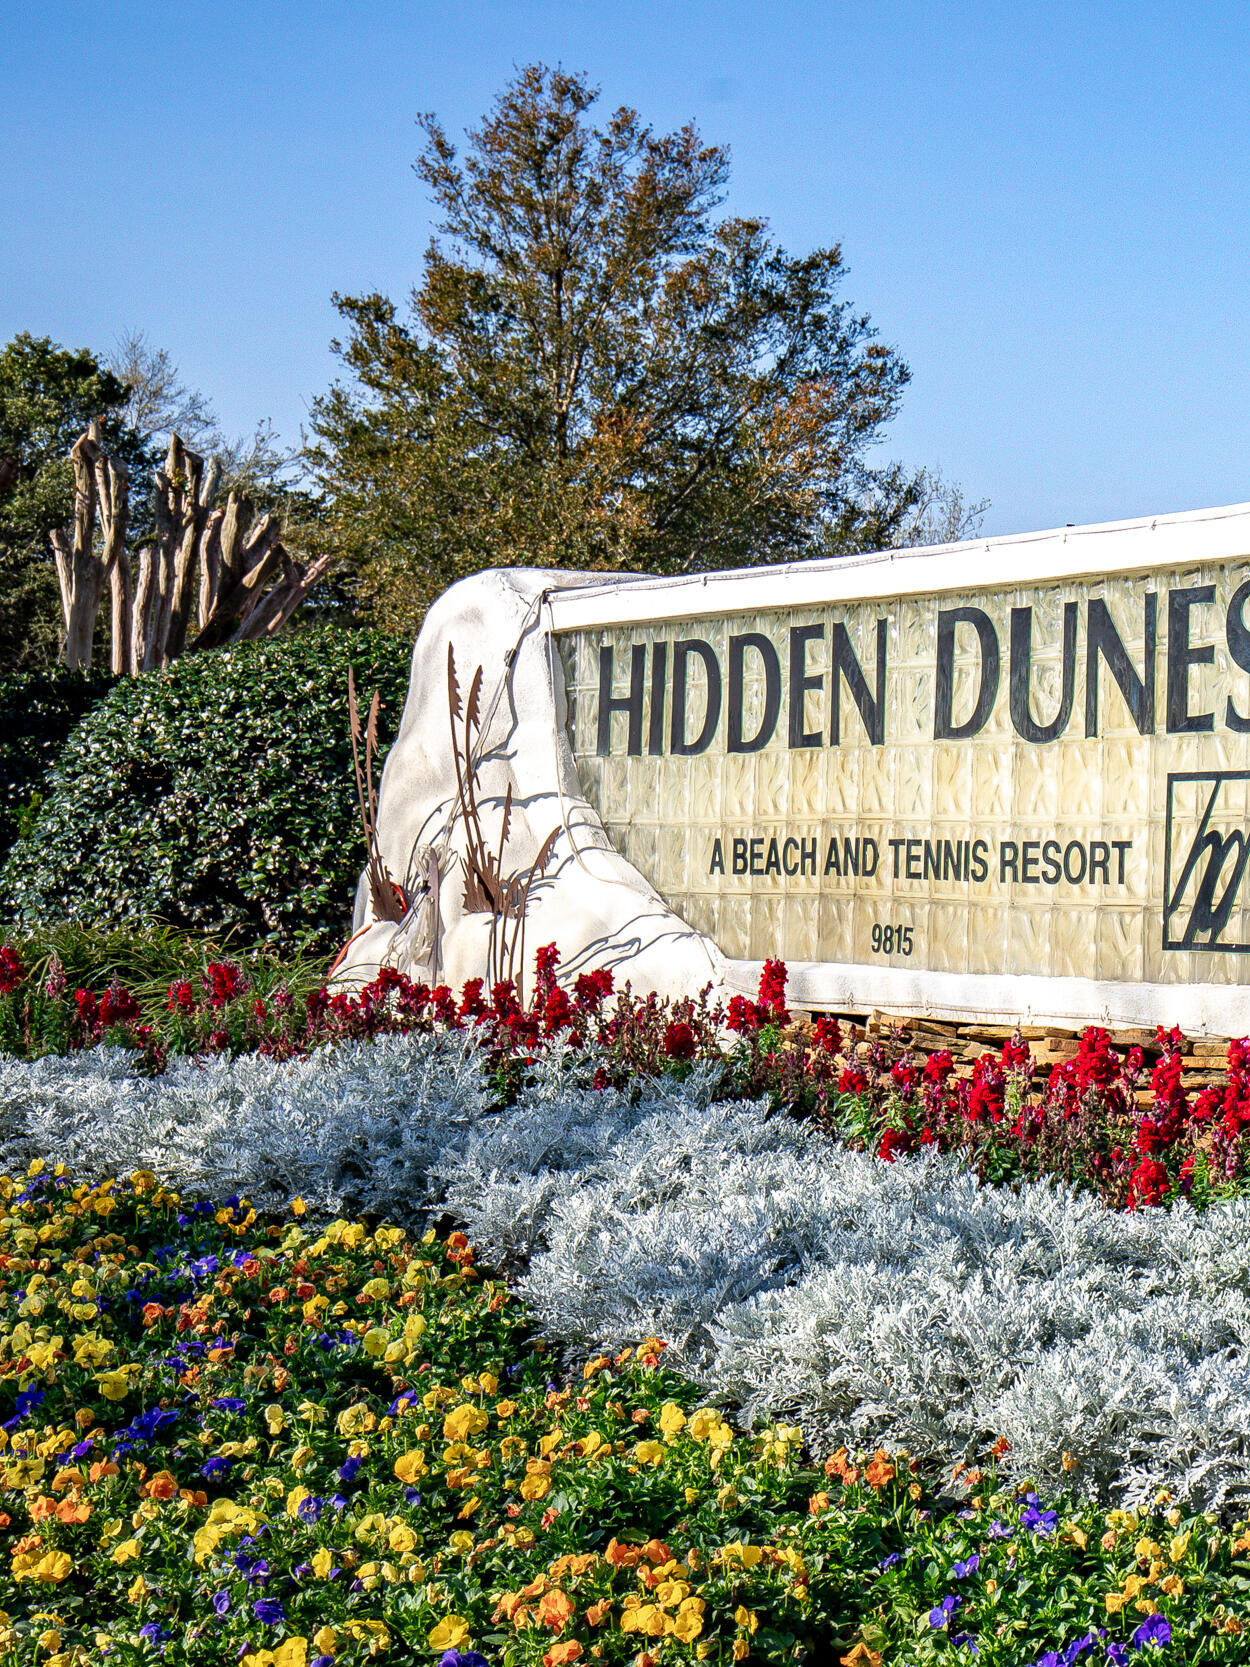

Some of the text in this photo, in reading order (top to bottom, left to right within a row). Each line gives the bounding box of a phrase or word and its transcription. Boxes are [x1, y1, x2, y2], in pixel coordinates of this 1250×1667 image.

[597, 616, 888, 757] HIDDEN
[709, 837, 1133, 885] A BEACH AND TENNIS RESORT
[871, 923, 914, 956] 9815
